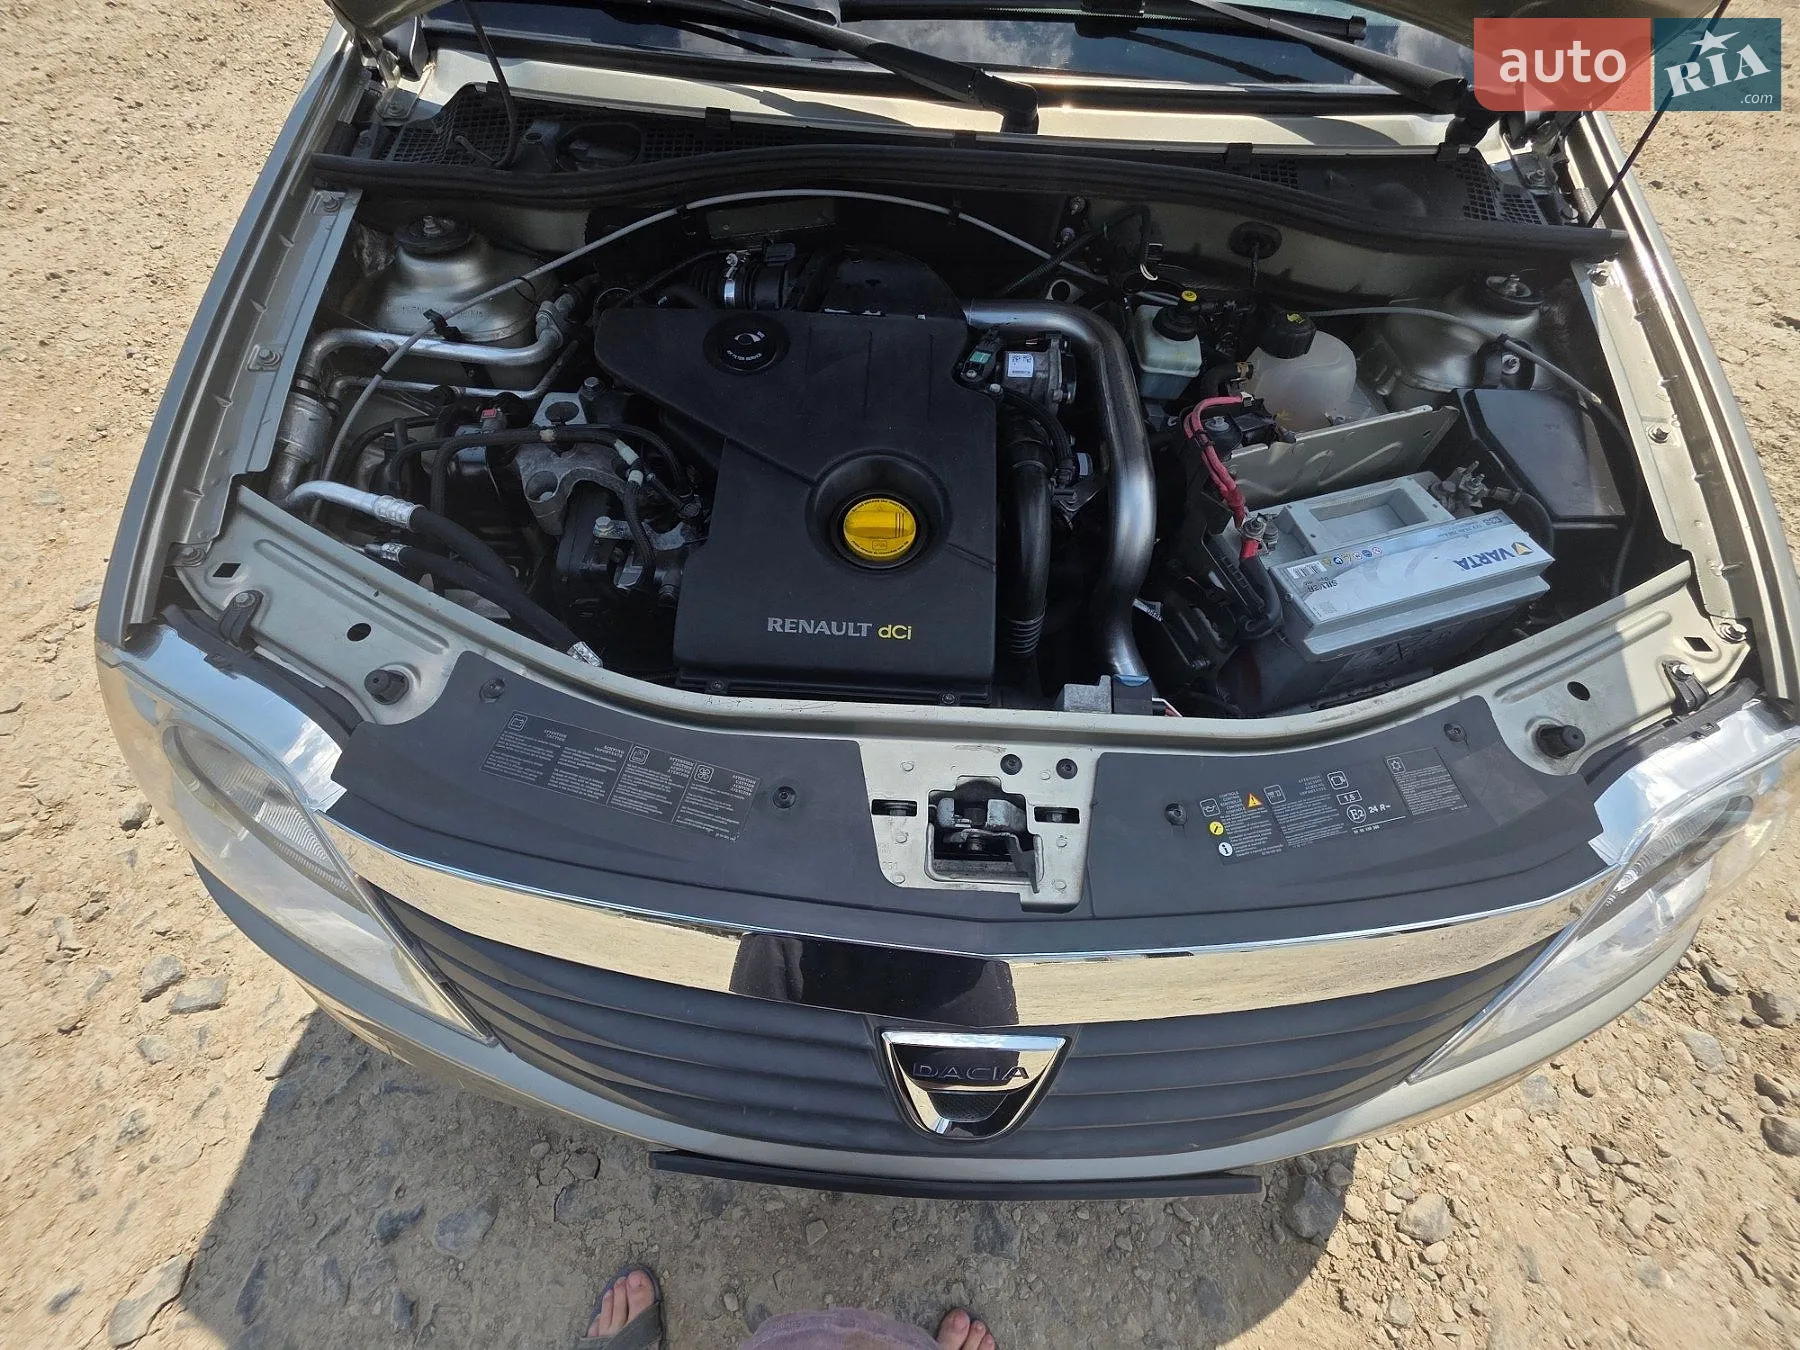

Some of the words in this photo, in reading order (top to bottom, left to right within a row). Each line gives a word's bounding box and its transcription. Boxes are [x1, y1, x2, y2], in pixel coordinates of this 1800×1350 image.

[1452, 547, 1516, 572] VARTA
[767, 617, 872, 638] RENAULT
[877, 624, 912, 641] dCi
[1343, 793, 1356, 803] 1,5
[1349, 808, 1365, 821] E2
[1368, 805, 1379, 814] 24
[911, 1061, 1030, 1081] DACIA
